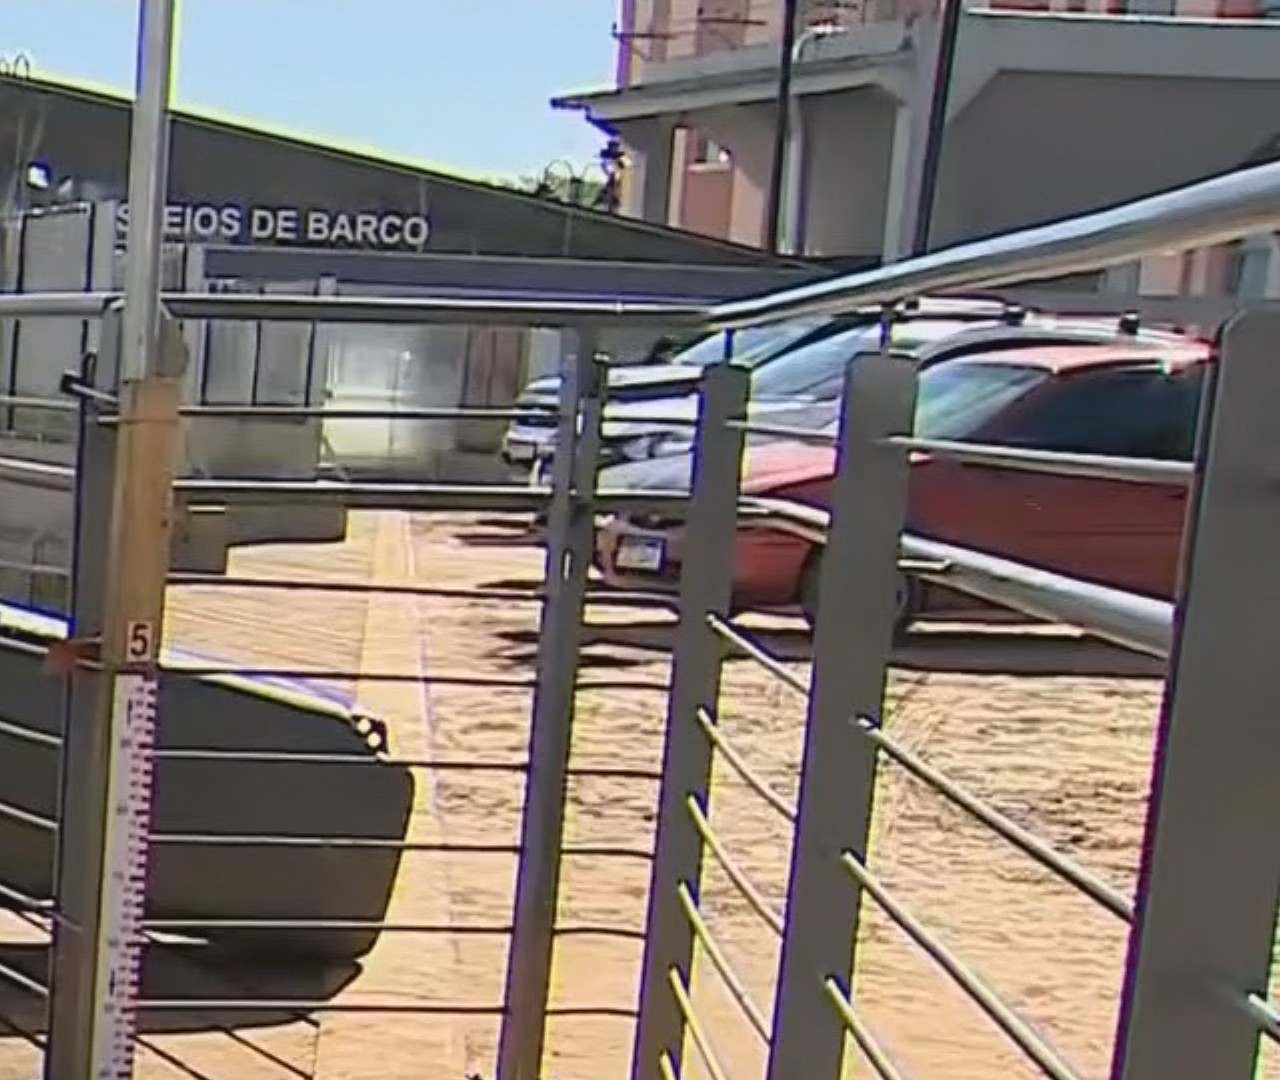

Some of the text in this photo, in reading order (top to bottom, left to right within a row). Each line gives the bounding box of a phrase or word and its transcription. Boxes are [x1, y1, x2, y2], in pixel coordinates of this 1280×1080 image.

[252, 208, 298, 239] DE
[307, 210, 429, 245] BARCO
[130, 622, 150, 657] 5
